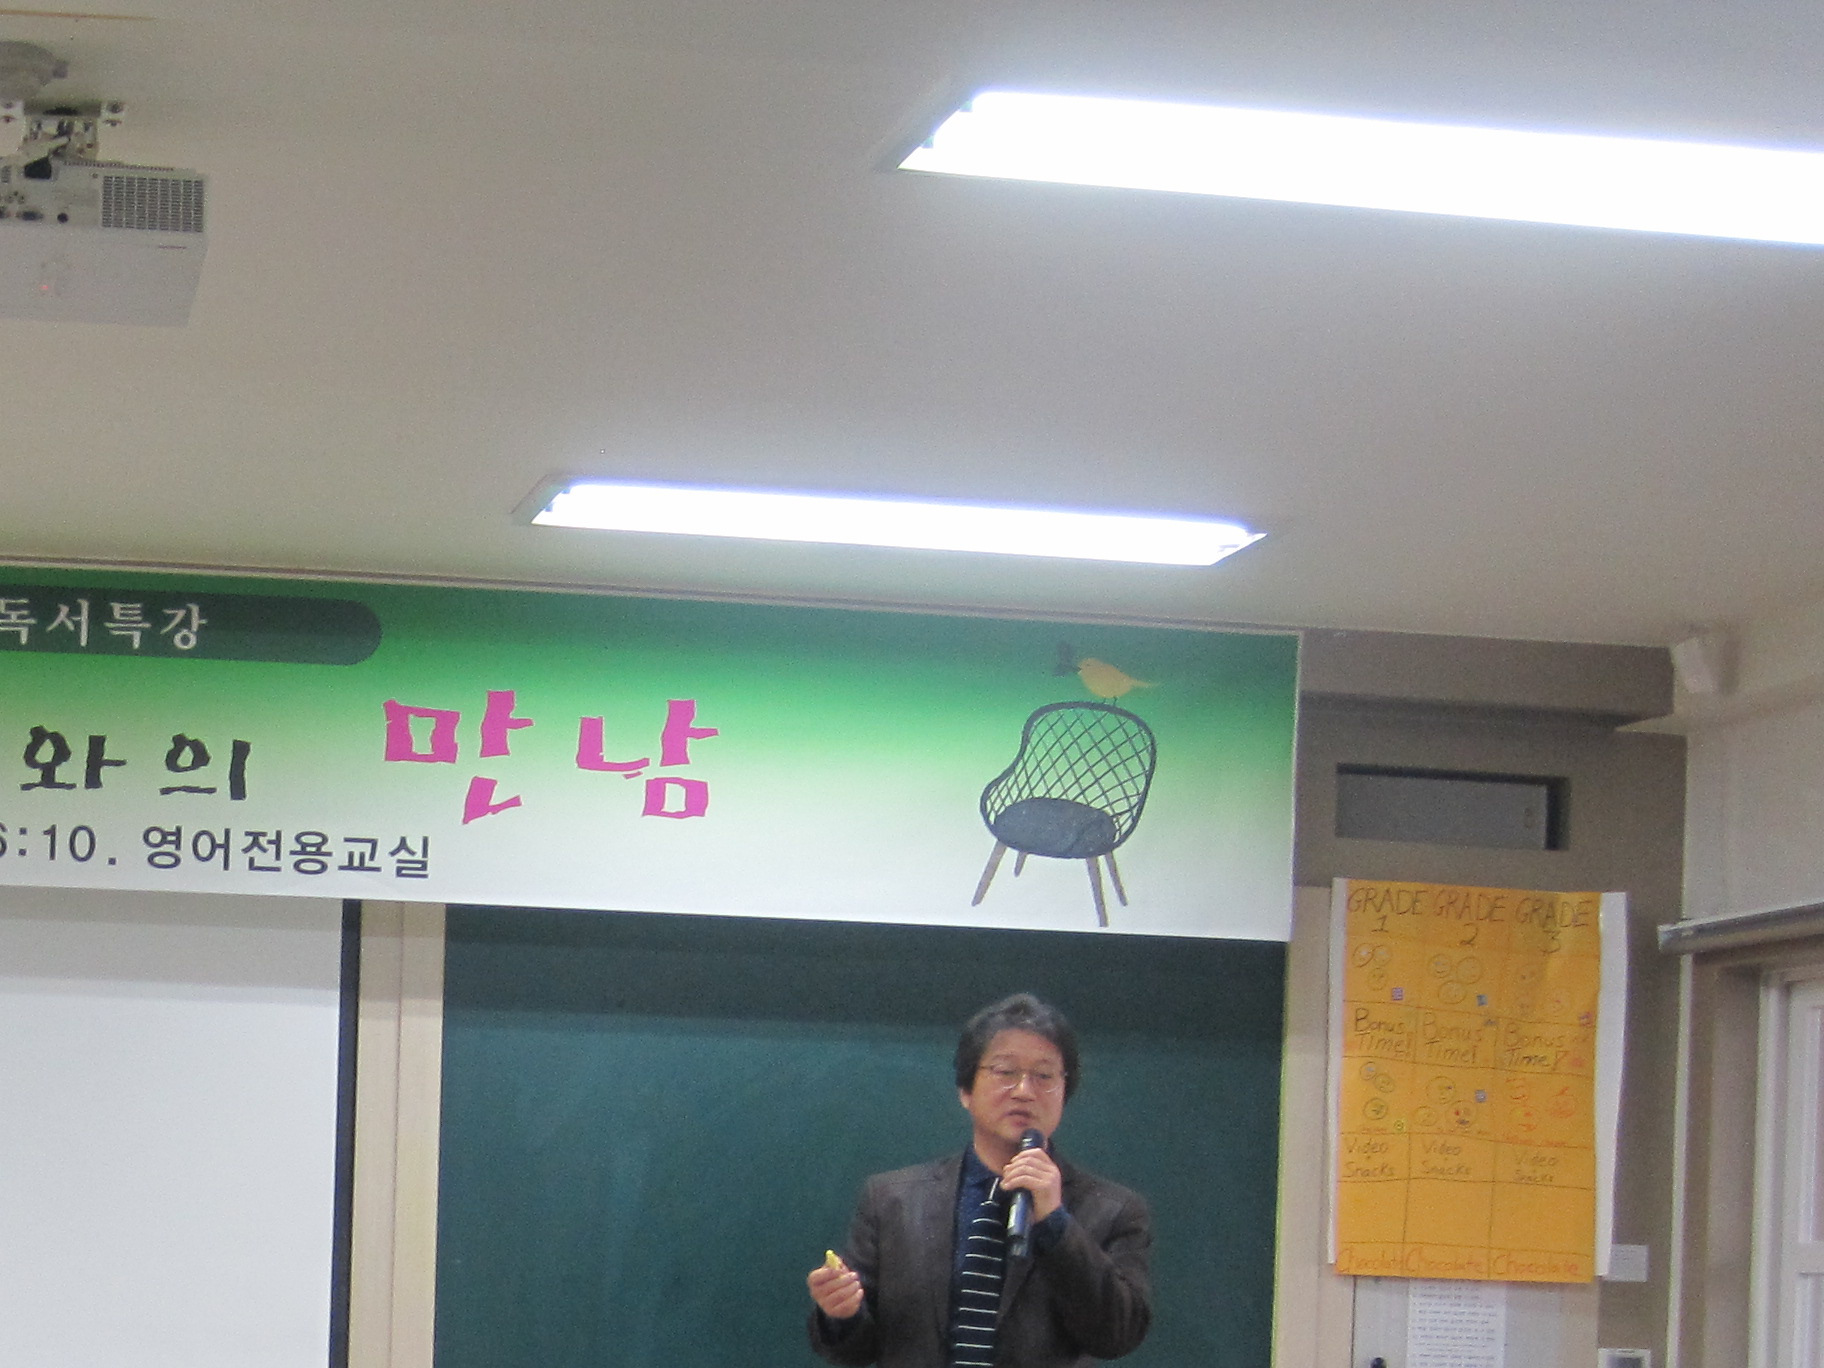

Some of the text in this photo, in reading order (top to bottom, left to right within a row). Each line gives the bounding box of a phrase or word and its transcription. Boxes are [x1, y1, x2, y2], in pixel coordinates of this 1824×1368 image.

[382, 690, 720, 825] 만남
[142, 823, 431, 880] 영어전용교실
[1346, 887, 1427, 916] GRADE
[1433, 889, 1507, 922] GRADE
[1514, 897, 1592, 928] GRADE
[1371, 915, 1389, 933] 1
[1539, 929, 1562, 954] 3
[1354, 1007, 1405, 1034] Bonus
[1422, 1011, 1483, 1043] Bonus
[1503, 1021, 1566, 1048] Bonus
